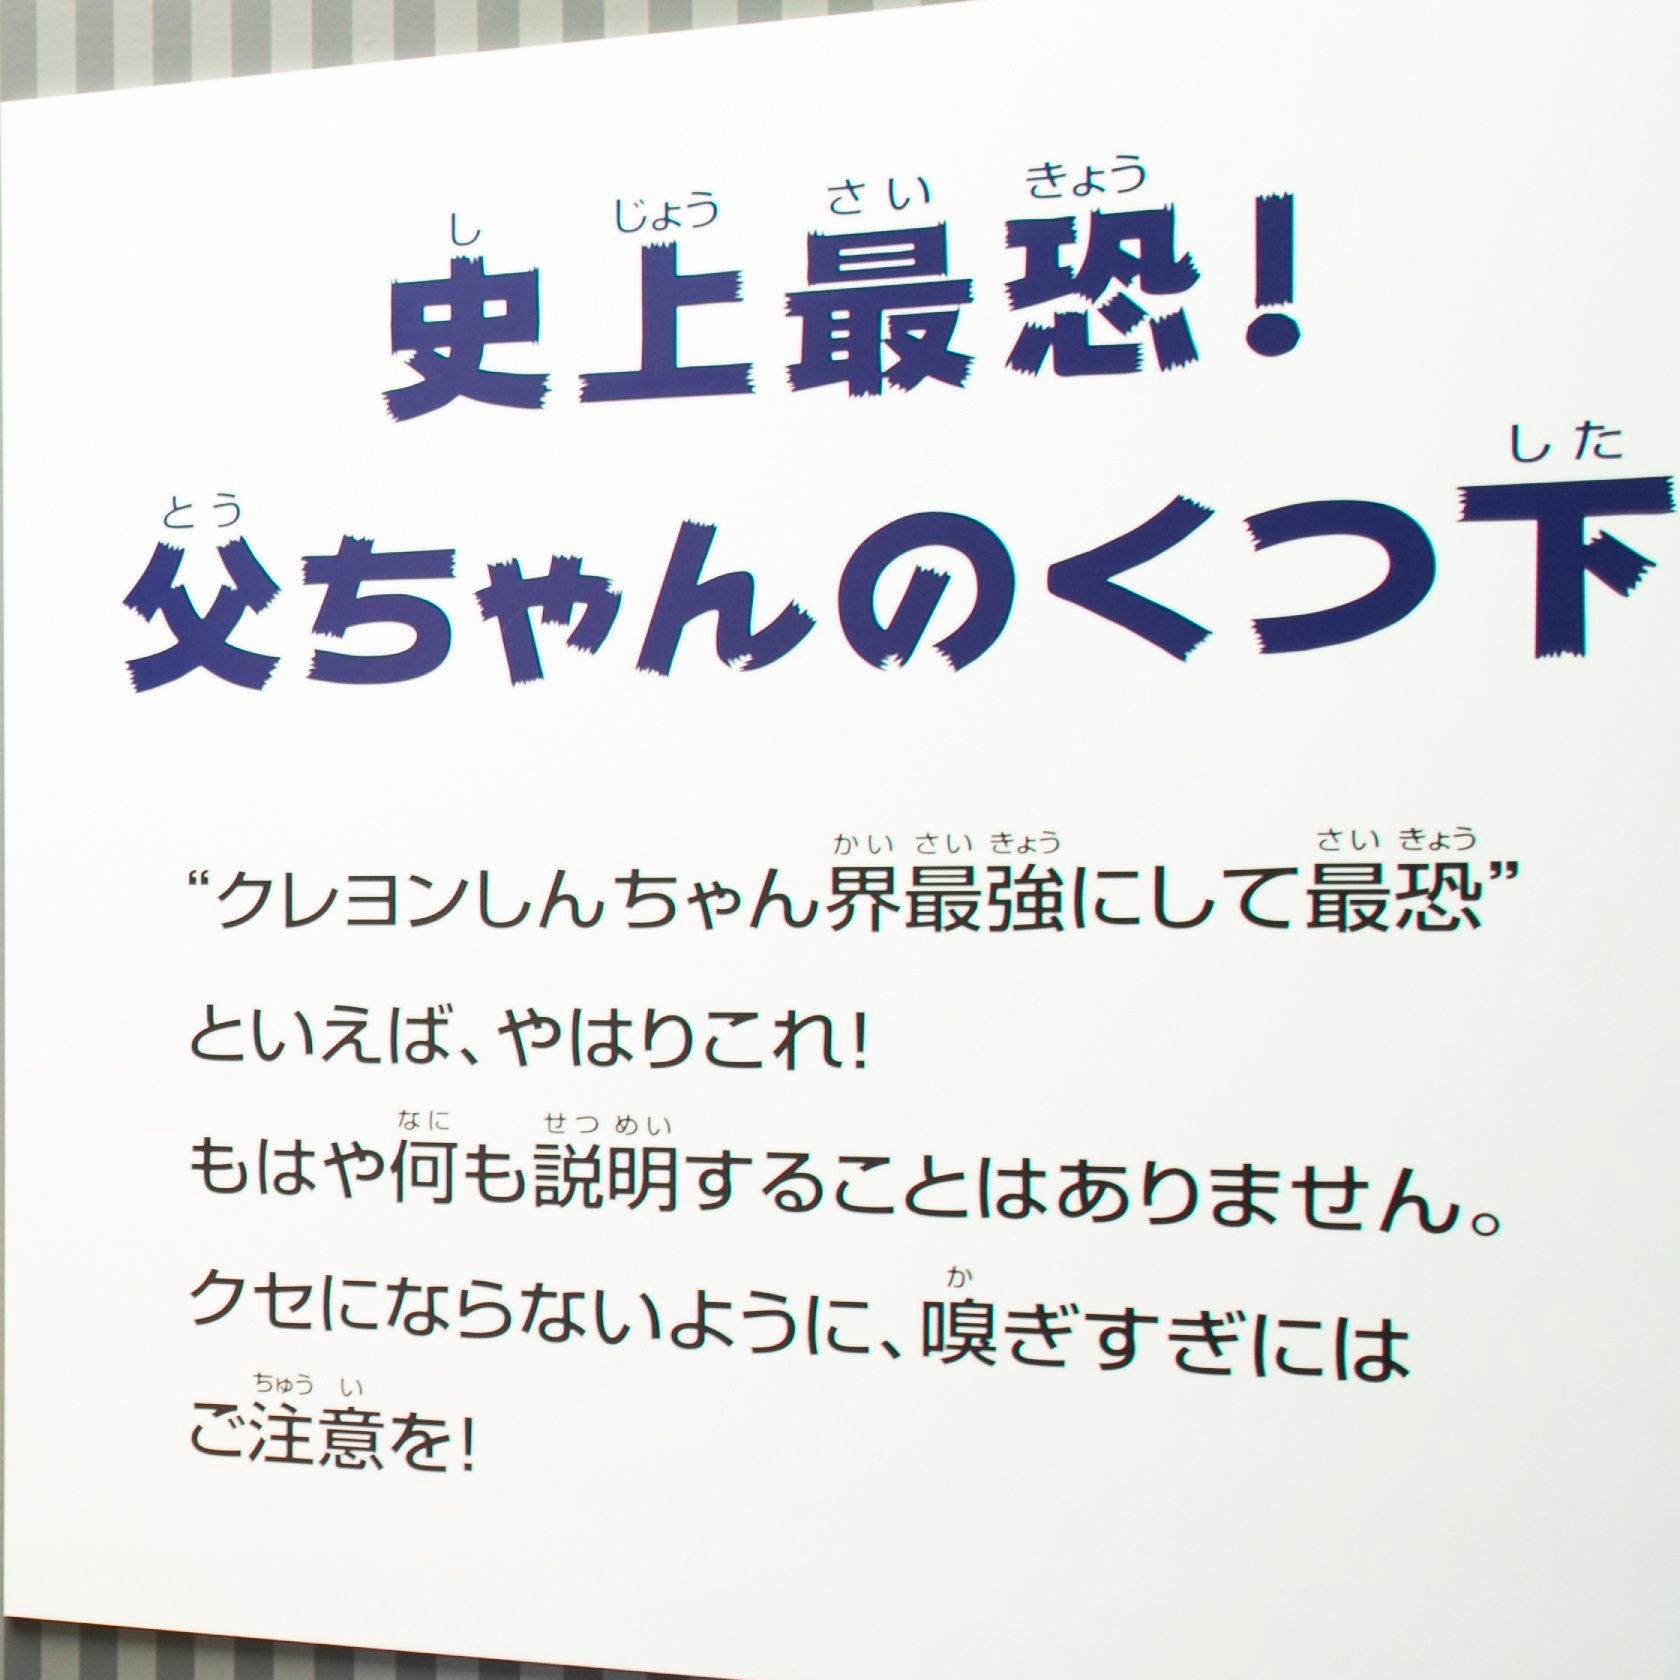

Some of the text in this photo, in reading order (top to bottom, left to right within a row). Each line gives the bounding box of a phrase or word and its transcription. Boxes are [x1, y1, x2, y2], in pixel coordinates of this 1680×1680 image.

[450, 154, 1147, 247] し じょう さい きょう
[381, 192, 1301, 423] 史上最恐！
[1511, 419, 1623, 464] した
[162, 492, 241, 530] とう
[122, 475, 1676, 693] 父ちゃんのくつ下
[833, 826, 1477, 856] かい さい きょう さい きょう
[191, 1003, 865, 1071] といえば、やはりこれ！
[398, 1109, 671, 1137] なに せつ めい
[191, 1137, 1500, 1237] もはや何も説明することはありません。
[947, 1265, 973, 1289] か
[190, 1269, 1410, 1383] クセにならないように、嗅ぎすぎには
[253, 1372, 313, 1396] ちゅう
[191, 1401, 472, 1473] ご注意を！
